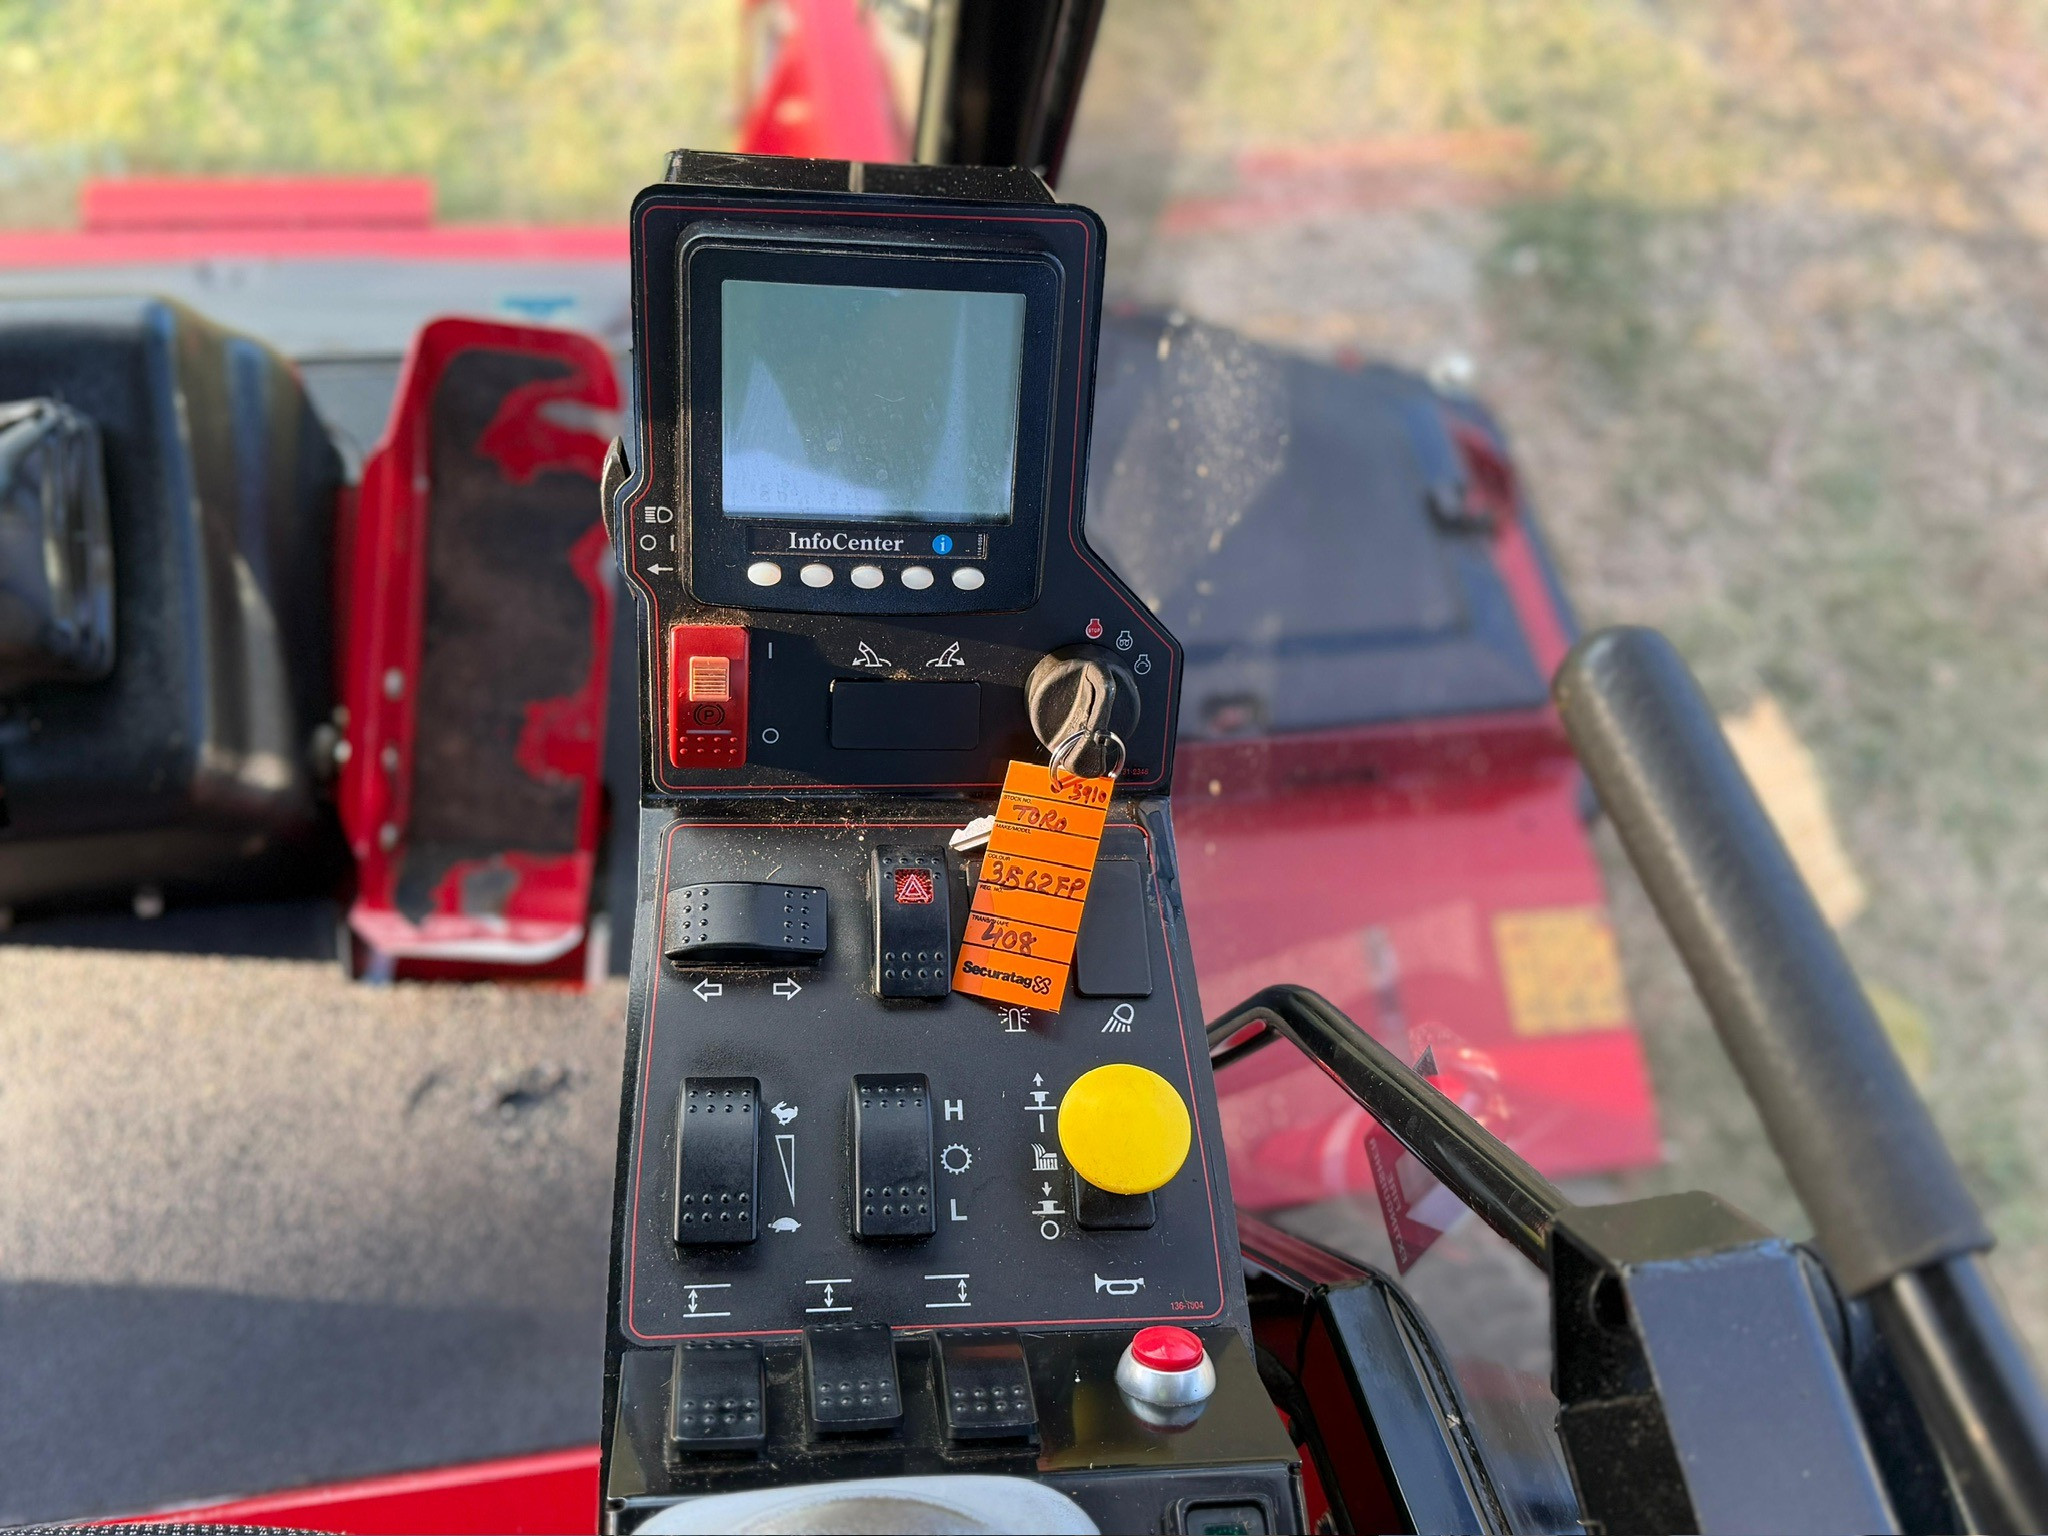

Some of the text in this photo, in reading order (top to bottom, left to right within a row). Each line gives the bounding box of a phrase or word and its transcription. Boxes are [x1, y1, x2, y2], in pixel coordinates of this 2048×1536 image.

[789, 531, 904, 551] InfoCenter
[1003, 794, 1022, 802] STOCK
[1013, 804, 1068, 832] TORO
[988, 853, 1011, 861] COLOUR
[981, 922, 1037, 956] 408
[962, 960, 1033, 989] Securatag
[944, 1099, 964, 1121] H
[950, 1199, 968, 1221] L
